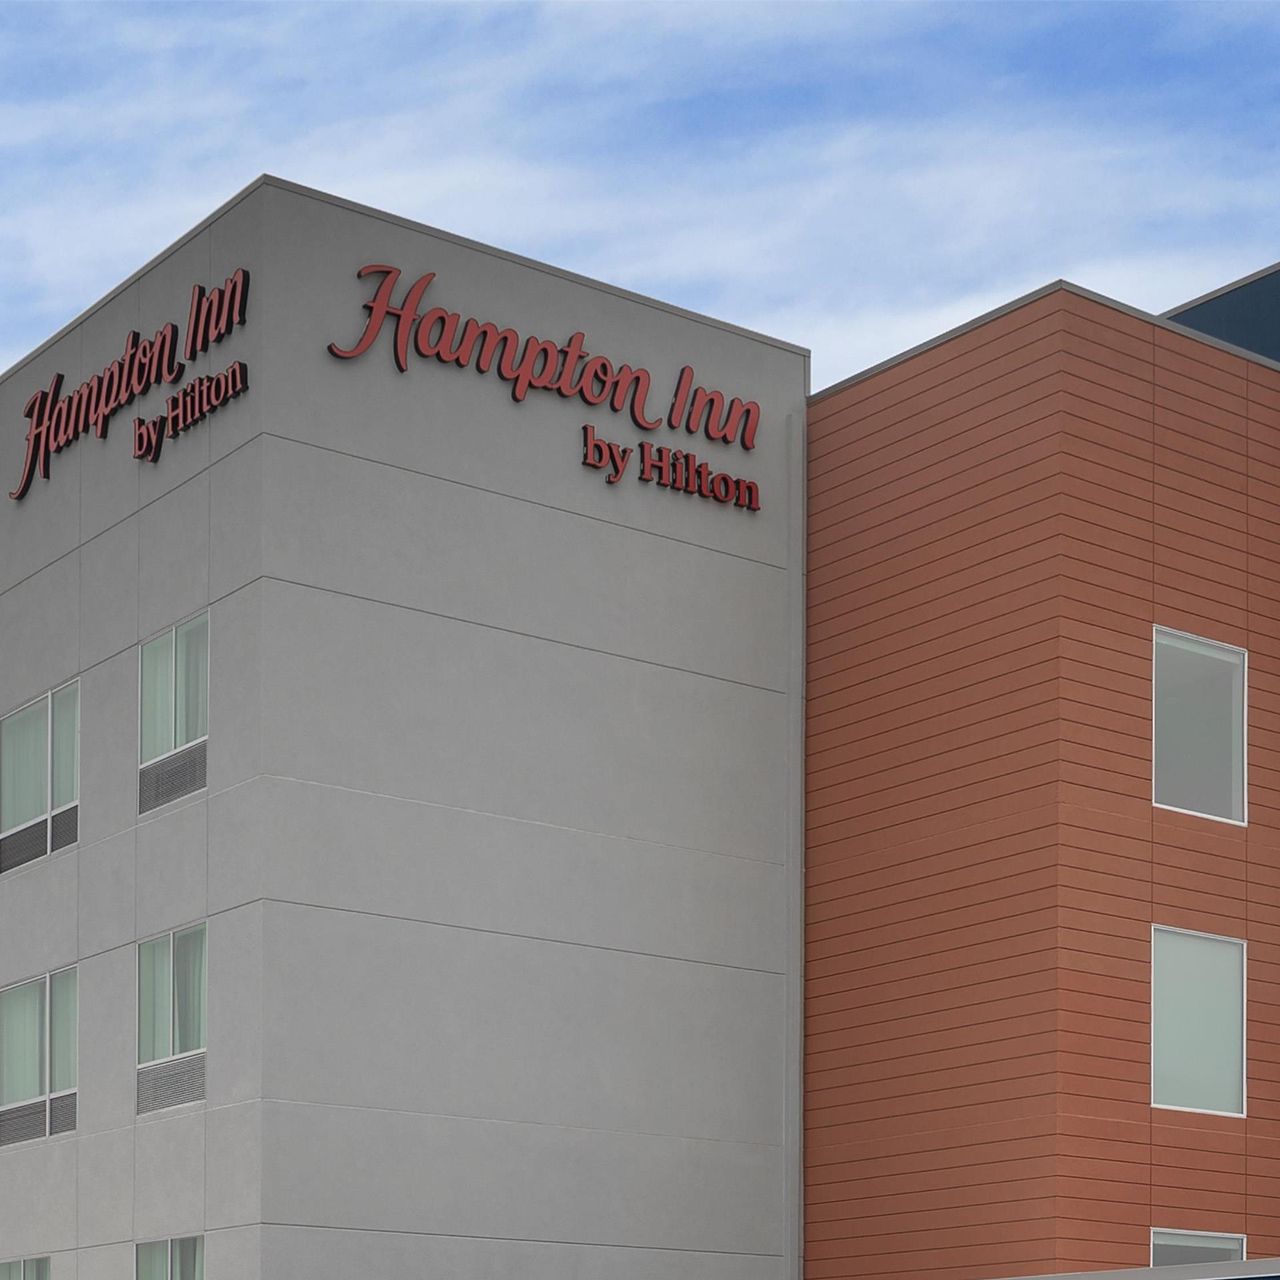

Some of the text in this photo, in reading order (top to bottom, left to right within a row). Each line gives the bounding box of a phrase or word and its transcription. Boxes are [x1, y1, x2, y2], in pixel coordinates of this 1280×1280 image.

[9, 268, 250, 500] Hampton Inn
[132, 360, 249, 463] by Hilton
[327, 264, 761, 449] Hampton Inn
[582, 424, 761, 511] by Hilton
